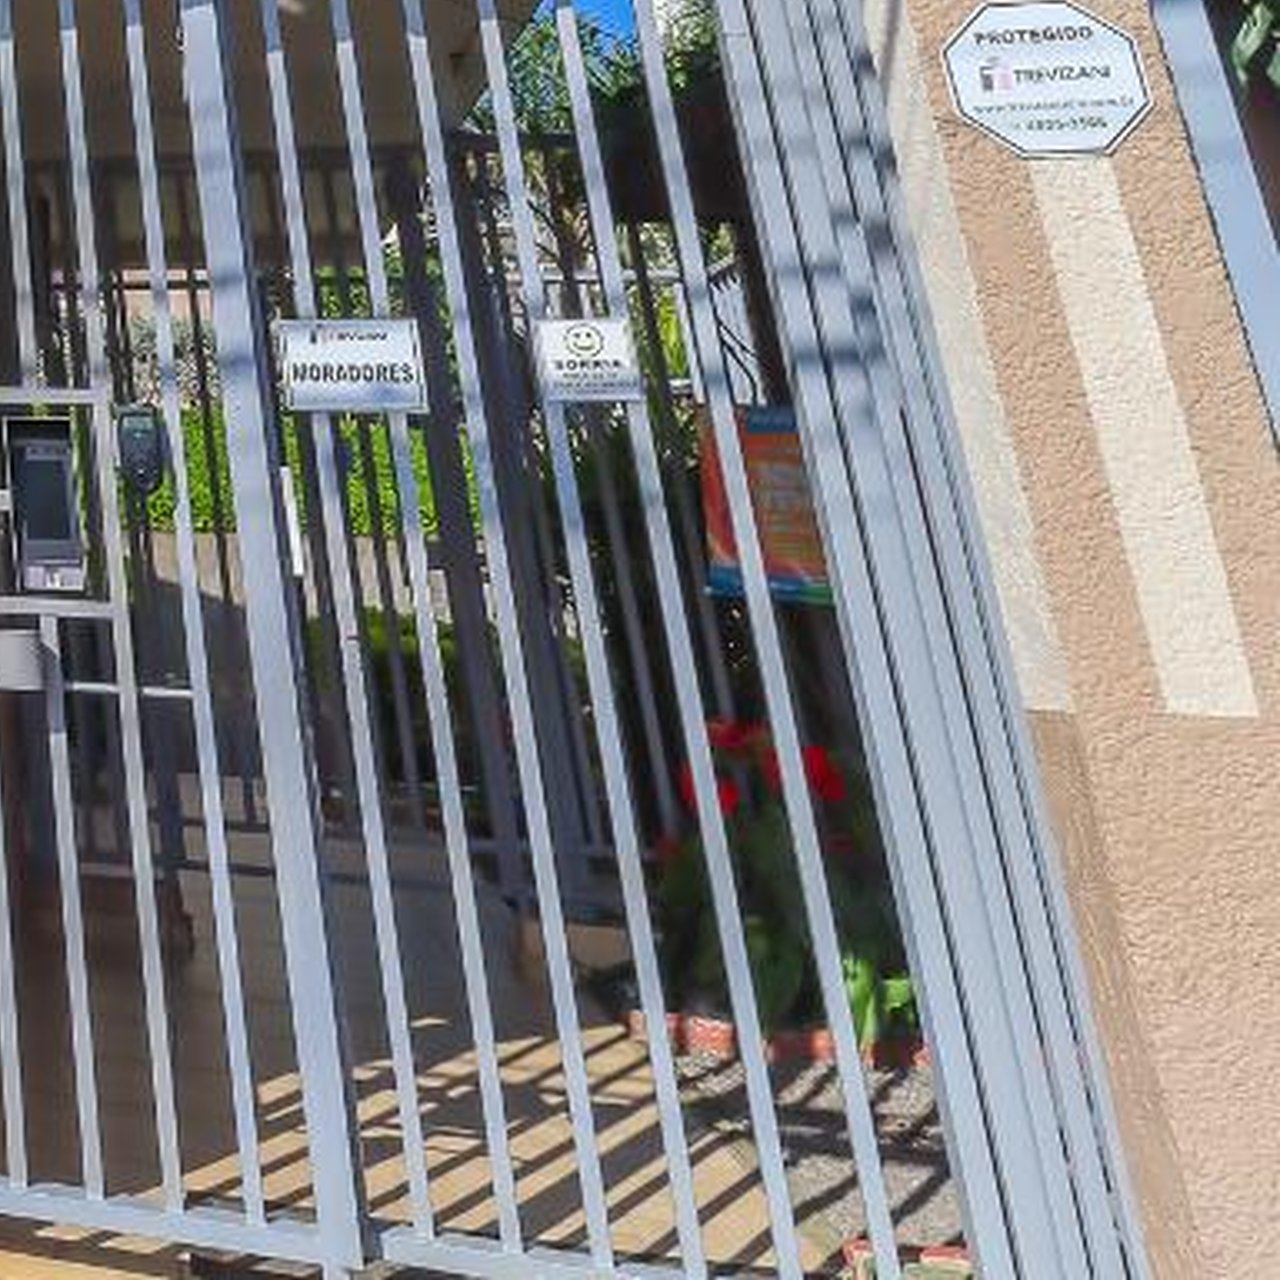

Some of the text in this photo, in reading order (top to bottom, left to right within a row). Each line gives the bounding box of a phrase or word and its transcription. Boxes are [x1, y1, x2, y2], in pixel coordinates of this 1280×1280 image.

[974, 26, 1093, 46] PROTEGIDO
[1013, 66, 1111, 84] TREVIZANI
[292, 363, 414, 383] MORADORES
